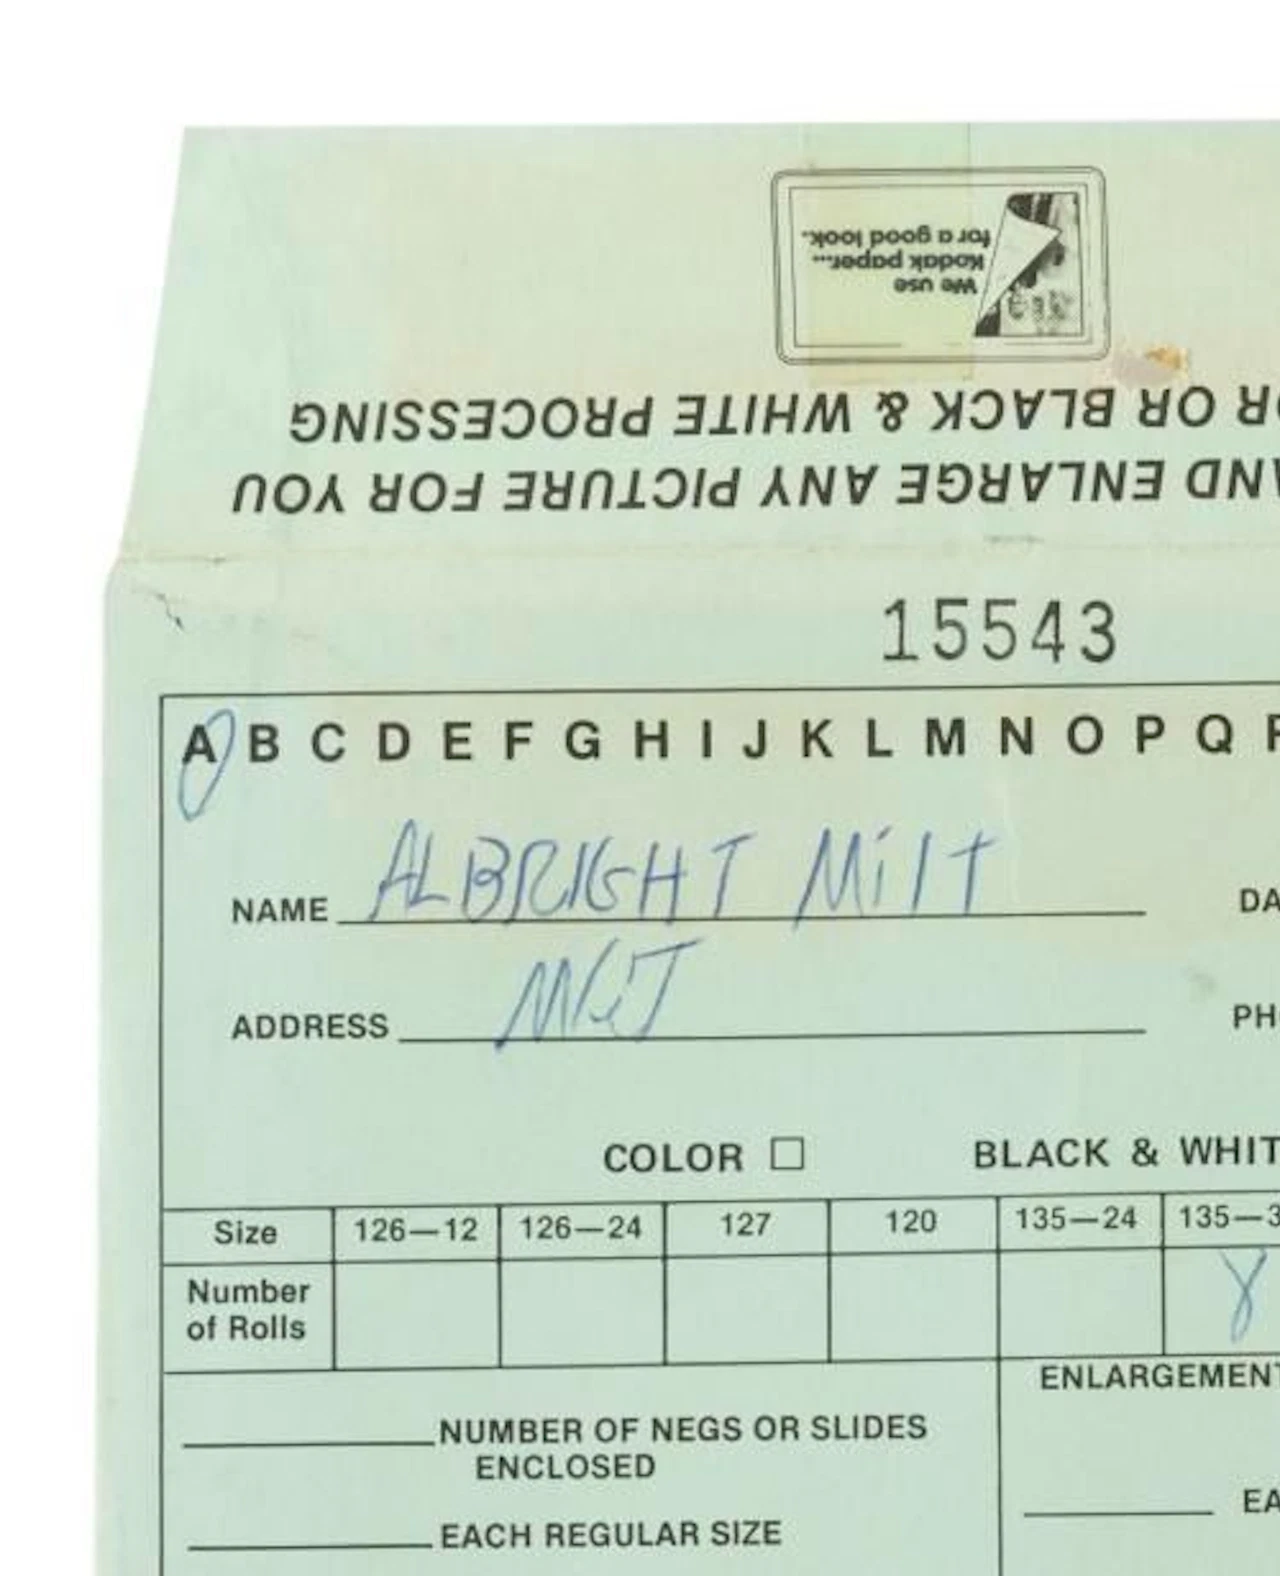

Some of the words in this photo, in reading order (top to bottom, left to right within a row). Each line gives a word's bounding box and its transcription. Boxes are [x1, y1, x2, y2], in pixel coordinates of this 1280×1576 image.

[802, 230, 862, 246] look.
[870, 225, 930, 246] good
[939, 230, 953, 244] a
[958, 230, 990, 247] for
[812, 250, 903, 268] paper...
[910, 255, 983, 271] Kodak
[894, 278, 933, 293] use
[941, 278, 976, 294] We
[289, 395, 654, 444] PROCESSING
[672, 391, 851, 437] WHITE
[875, 390, 910, 434] &
[929, 387, 1116, 432] BLACK
[1137, 385, 1217, 429] OR
[231, 472, 346, 516] YOU
[368, 471, 485, 514] FOR
[502, 466, 742, 512] PICTURE
[759, 463, 880, 508] ANY
[895, 459, 1166, 506] ENLARGE
[882, 597, 1117, 665] 15543
[181, 722, 217, 763] A
[248, 723, 280, 764] B
[310, 721, 346, 763] C
[378, 721, 411, 762] D
[442, 720, 473, 762] E
[504, 720, 534, 761] F
[564, 719, 601, 761] G
[634, 719, 669, 761] H
[701, 718, 713, 759] I
[742, 718, 767, 760] J
[801, 718, 834, 759] K
[866, 717, 894, 758] L
[925, 716, 966, 758] M
[1000, 715, 1034, 757] N
[1066, 714, 1105, 756] O
[1135, 713, 1166, 755] P
[1195, 713, 1234, 756] Q
[232, 896, 329, 925] NAME
[231, 1012, 390, 1041] ADDRESS
[603, 1142, 744, 1174] COLOR
[974, 1137, 1110, 1170] BLACK
[1131, 1137, 1159, 1168] &
[214, 1219, 278, 1246] Size
[721, 1211, 772, 1237] 127
[886, 1208, 938, 1234] 120
[187, 1278, 311, 1305] Number
[186, 1314, 217, 1342] of
[229, 1313, 307, 1341] Rolls
[439, 1417, 583, 1445] NUMBER
[593, 1417, 640, 1444] OF
[651, 1415, 743, 1443] NEGS
[753, 1414, 800, 1442] OR
[810, 1413, 928, 1442] SLIDES
[475, 1453, 656, 1481] ENCLOSED
[440, 1522, 532, 1550] EACH
[545, 1520, 700, 1549] REGULAR
[710, 1519, 782, 1547] SIZE
